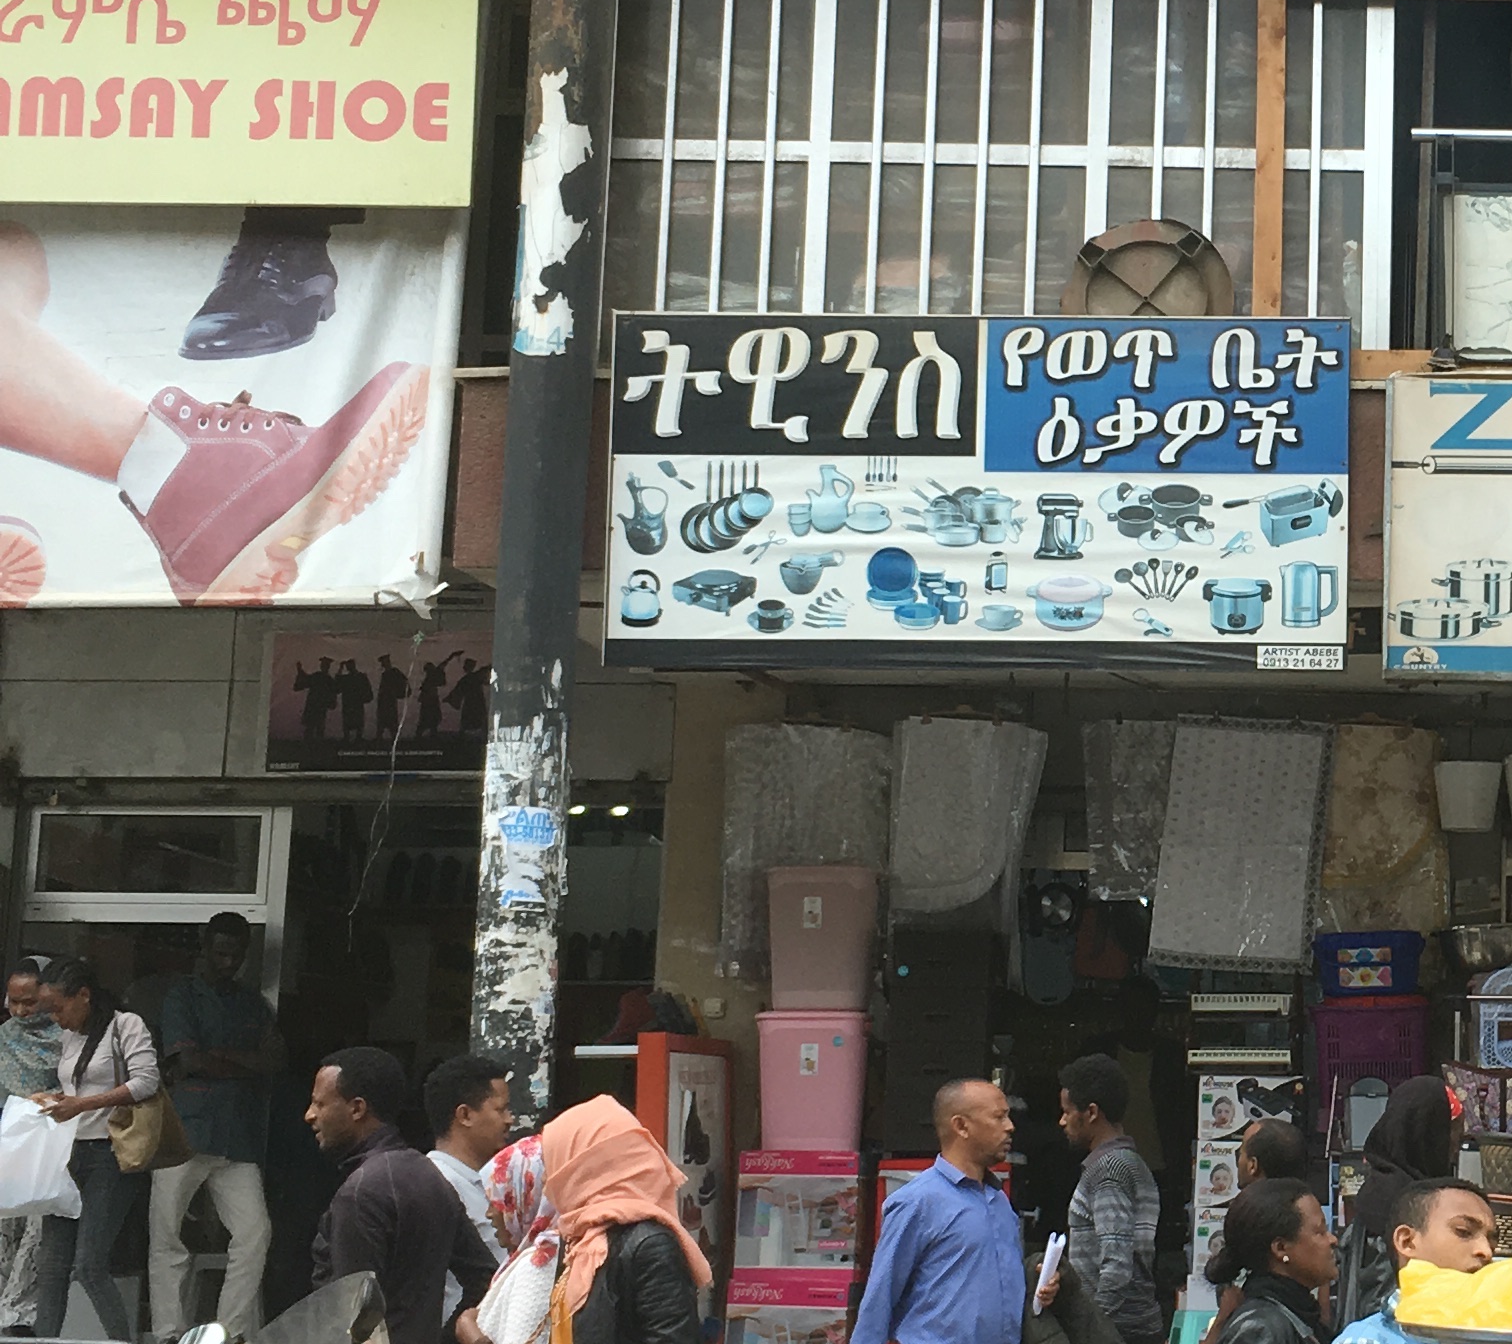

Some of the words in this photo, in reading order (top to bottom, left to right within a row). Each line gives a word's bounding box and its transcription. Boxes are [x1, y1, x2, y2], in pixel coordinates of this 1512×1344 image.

[248, 78, 450, 142] SHOE
[622, 327, 964, 443] ትዊንስ
[1002, 325, 1174, 389] የወጥ
[1210, 327, 1341, 390] ቤት
[1038, 395, 1299, 465] ዕቃዎች
[1263, 648, 1301, 657] ARTIST
[1304, 648, 1340, 657] ABEBE
[1293, 658, 1306, 668] 21
[1326, 658, 1339, 668] 27
